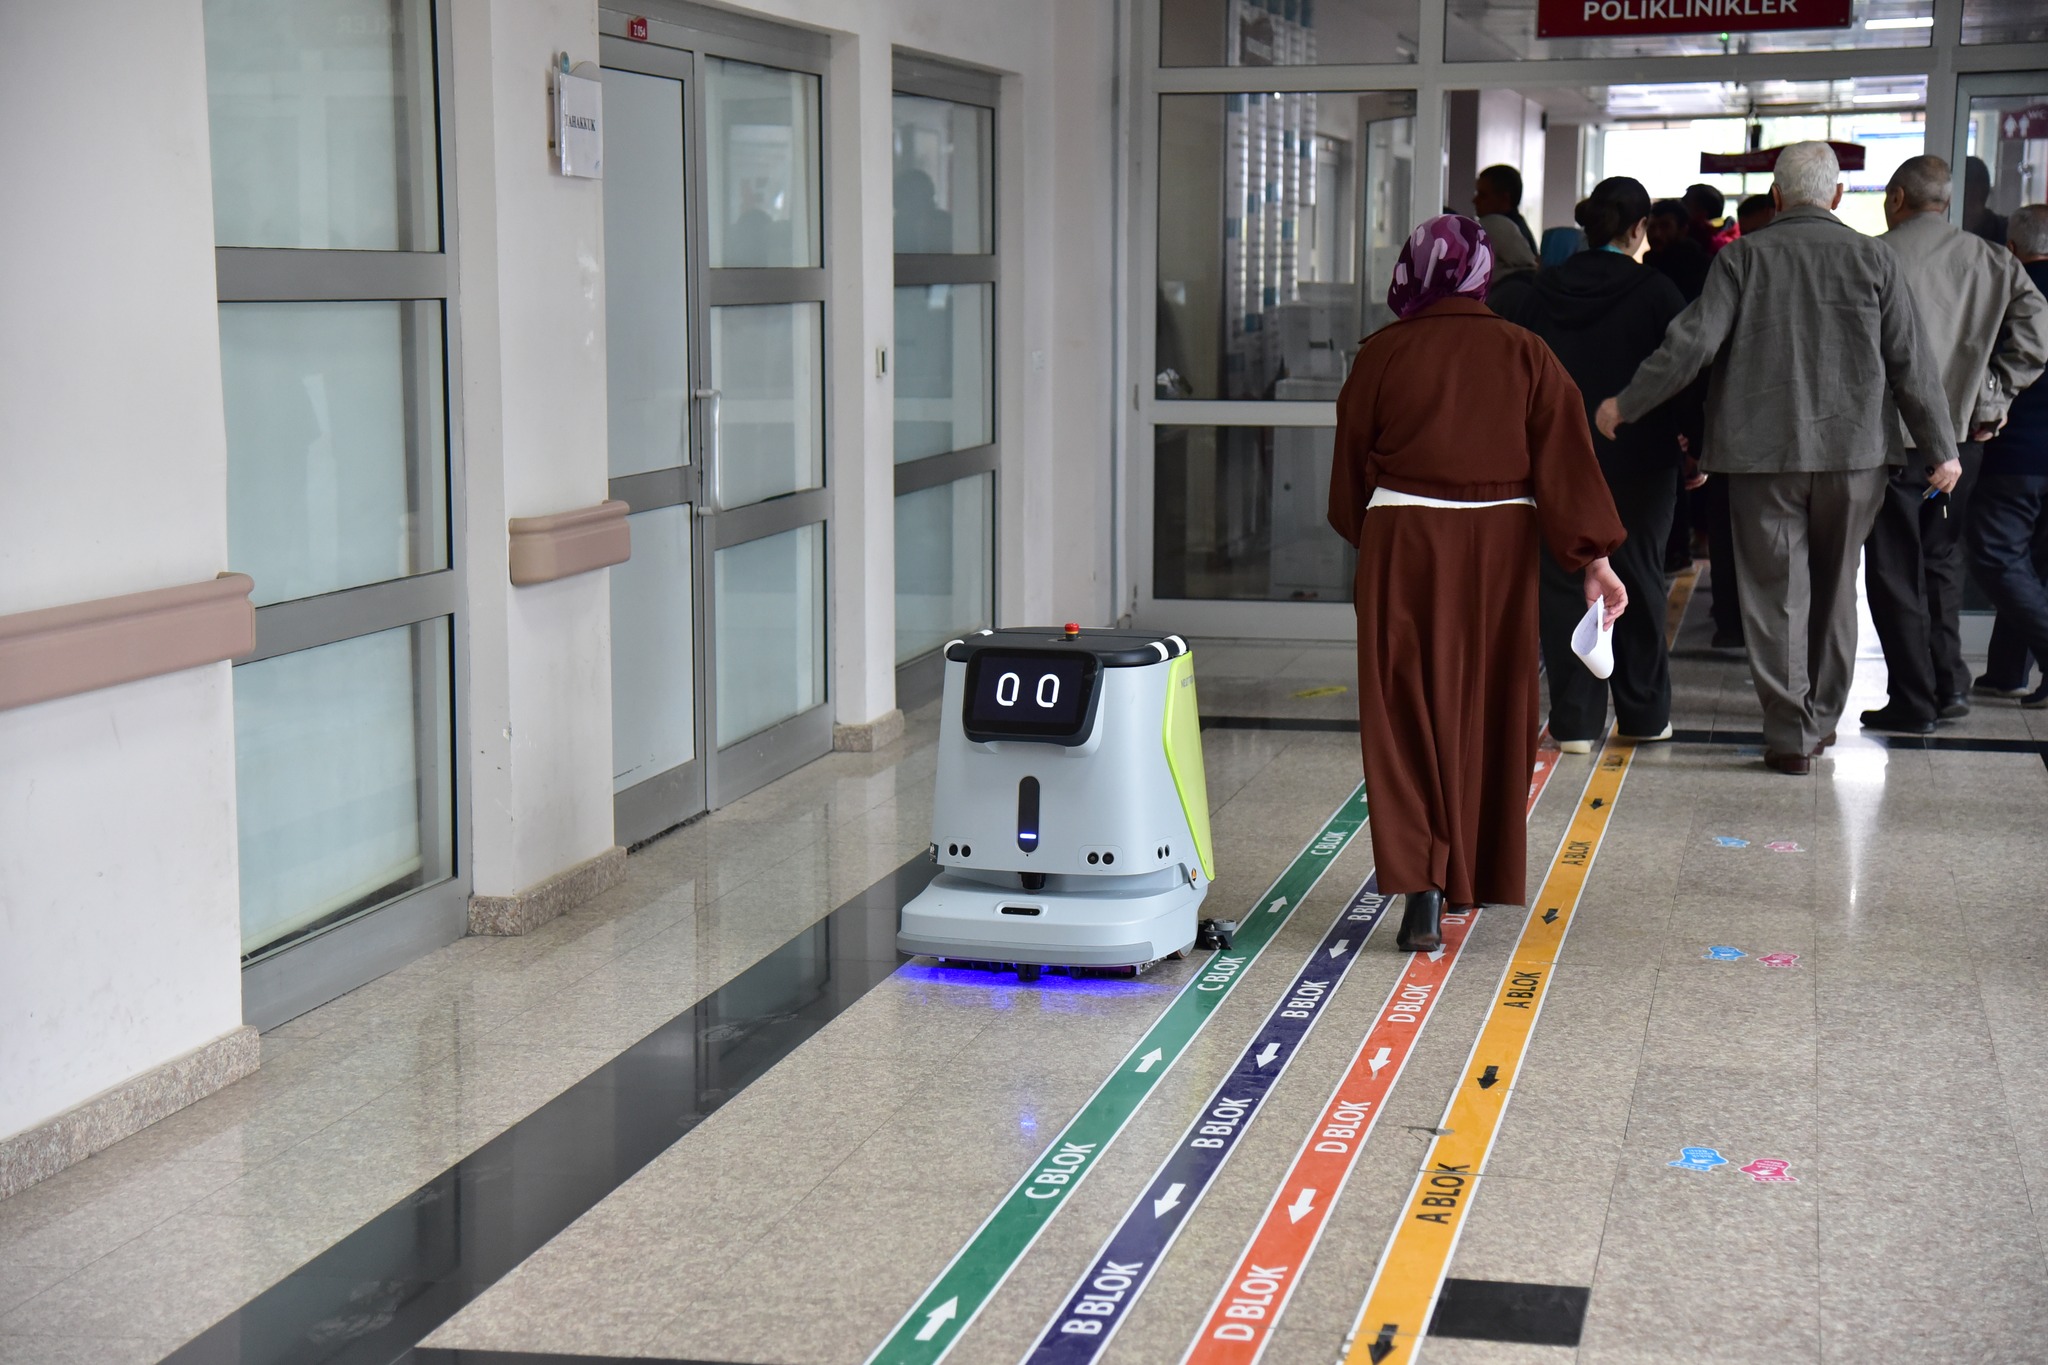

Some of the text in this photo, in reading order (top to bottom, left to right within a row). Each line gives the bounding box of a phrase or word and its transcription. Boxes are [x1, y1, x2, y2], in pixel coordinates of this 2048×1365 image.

[565, 114, 596, 132] TAHAKKUK
[1314, 831, 1349, 850] BLOK
[1564, 840, 1593, 859] BLOK
[1352, 891, 1387, 914] BLOK
[1440, 917, 1466, 925] D
[1196, 956, 1247, 991] C BLOK
[1503, 971, 1543, 1009] A BLOK
[1280, 980, 1330, 1018] B BLOK
[1387, 983, 1434, 1023] D BLOK
[1190, 1096, 1253, 1149] B BLOK
[1314, 1100, 1372, 1154] D BLOK
[1024, 1141, 1098, 1199] C BLOK
[1415, 1162, 1471, 1225] A BLOK
[1060, 1260, 1144, 1336] B BLOK
[1213, 1263, 1289, 1342] D BLOK
